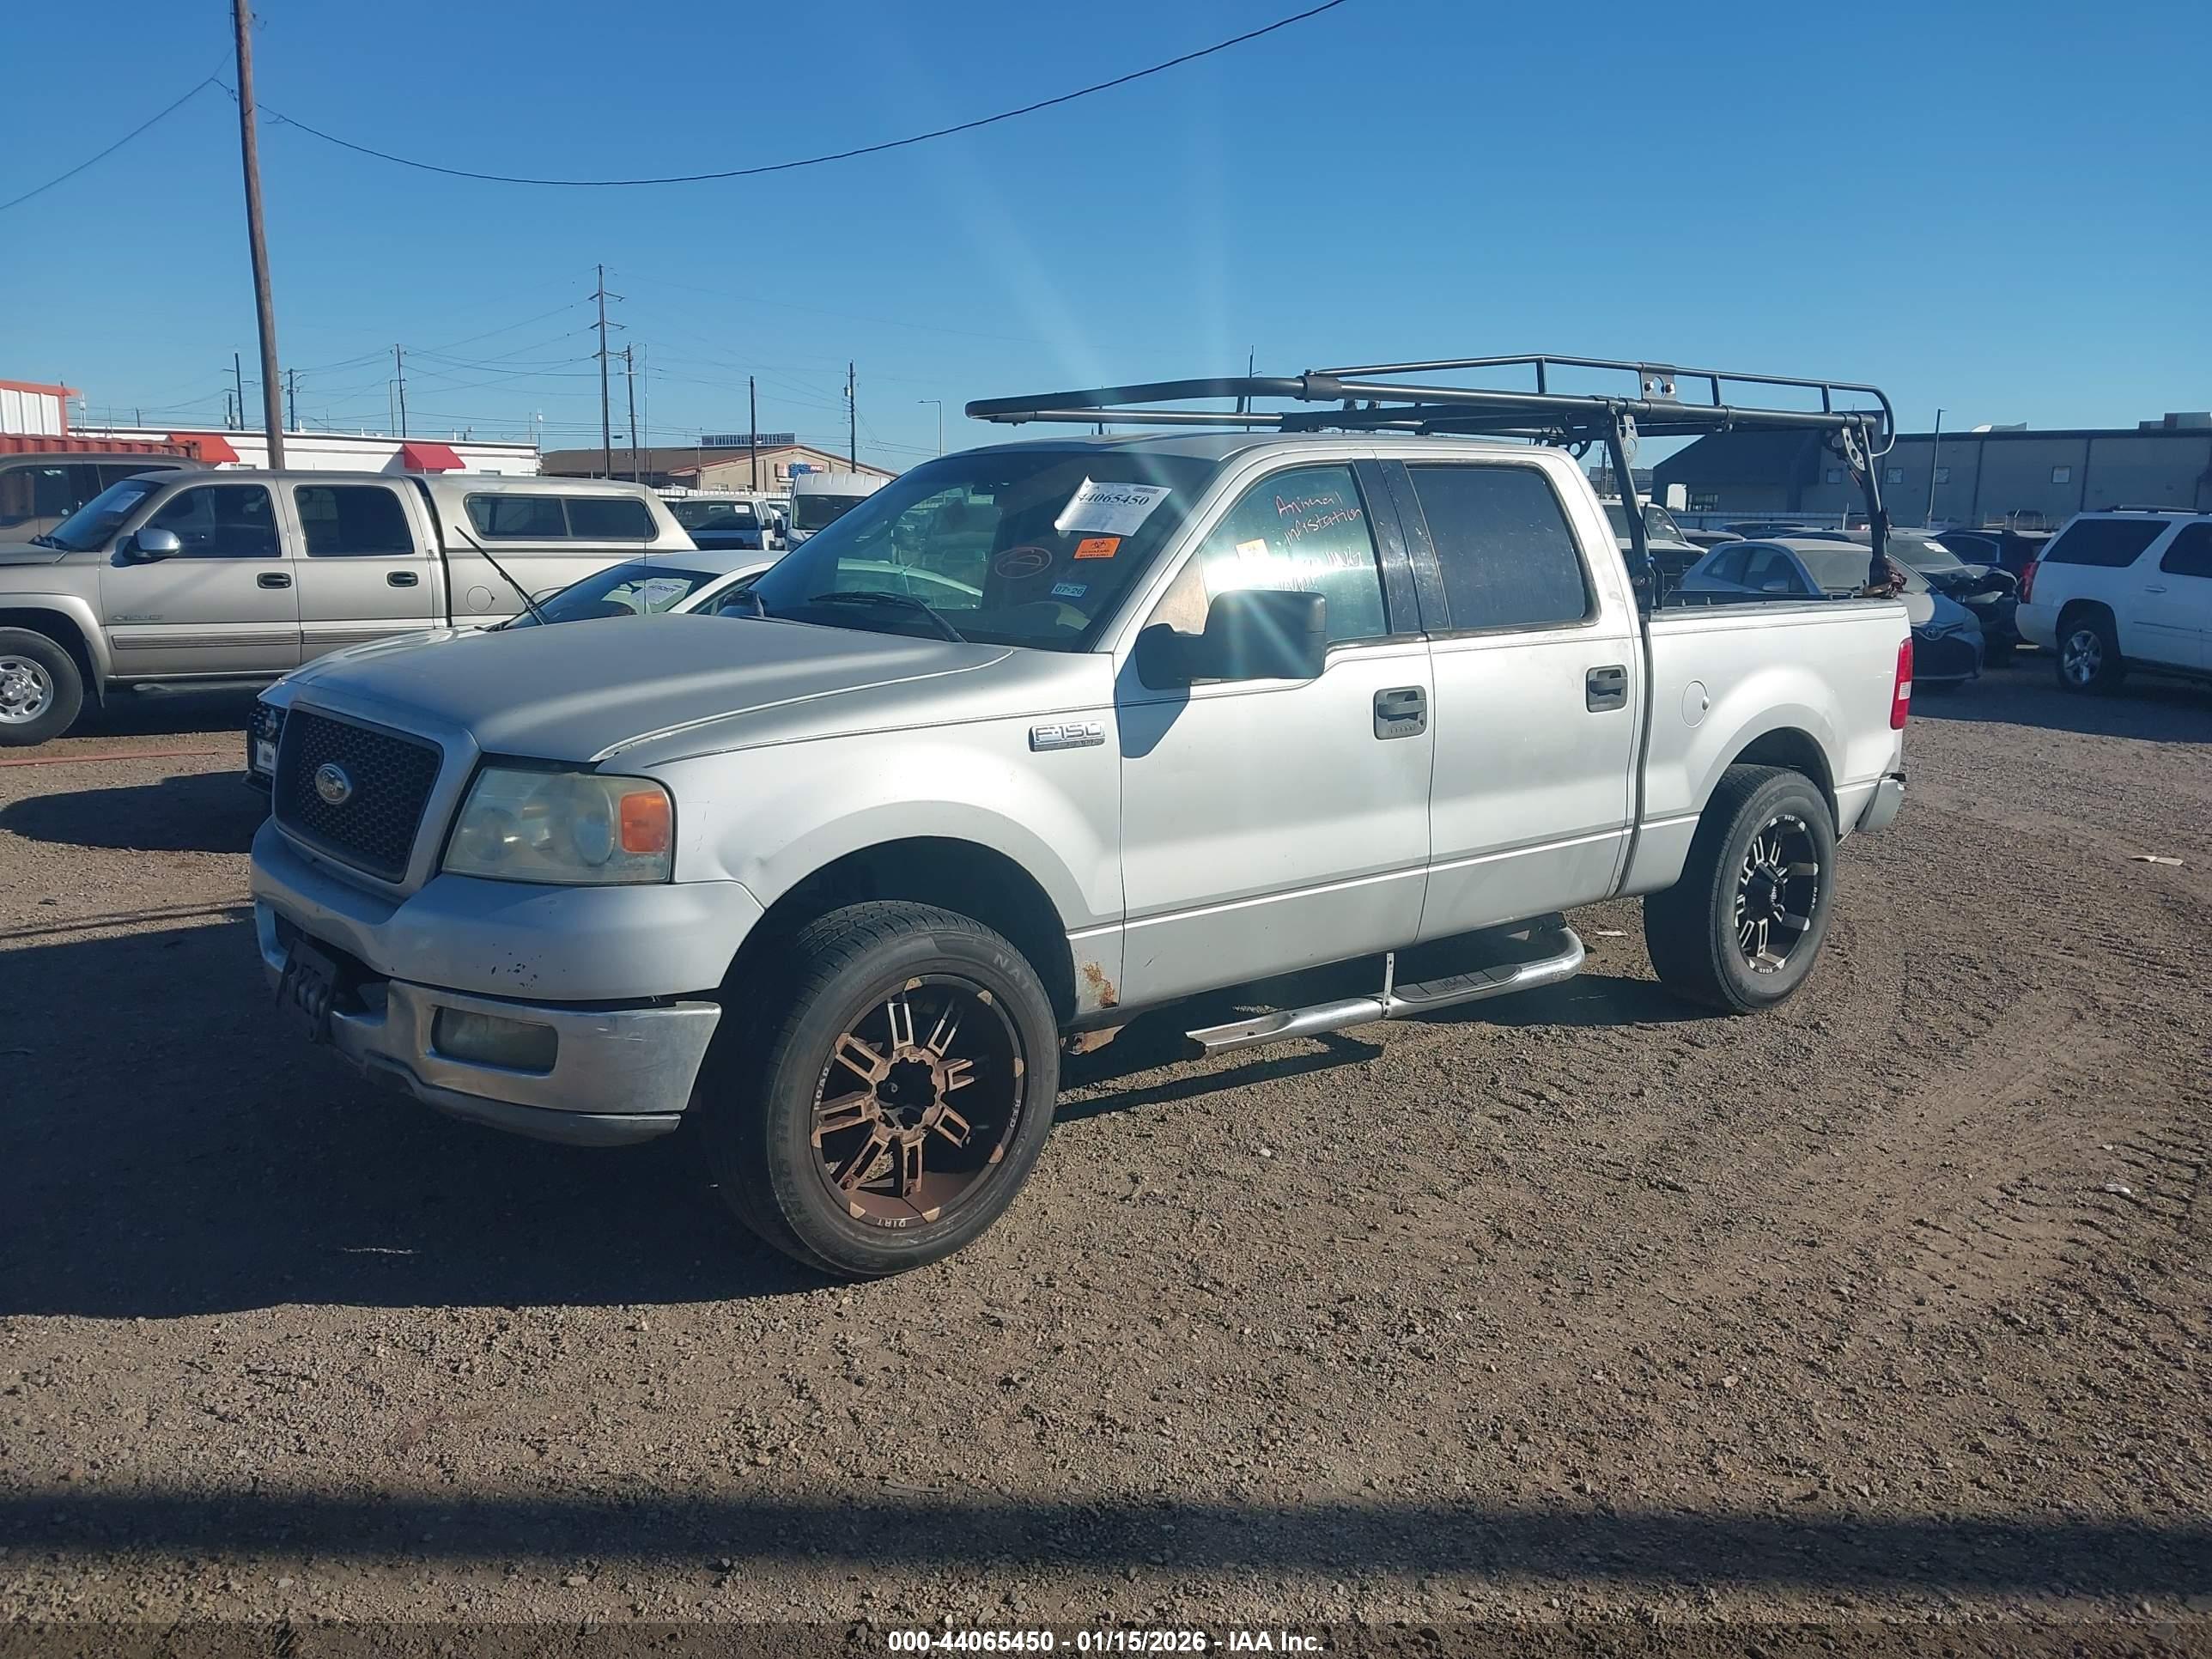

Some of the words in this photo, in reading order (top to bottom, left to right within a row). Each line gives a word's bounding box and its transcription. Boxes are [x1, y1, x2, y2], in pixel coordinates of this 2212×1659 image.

[1078, 493, 1150, 506] 44065450
[813, 1066, 830, 1111] ROAD
[1009, 1099, 1022, 1127] RED
[876, 1218, 907, 1228] DIRT
